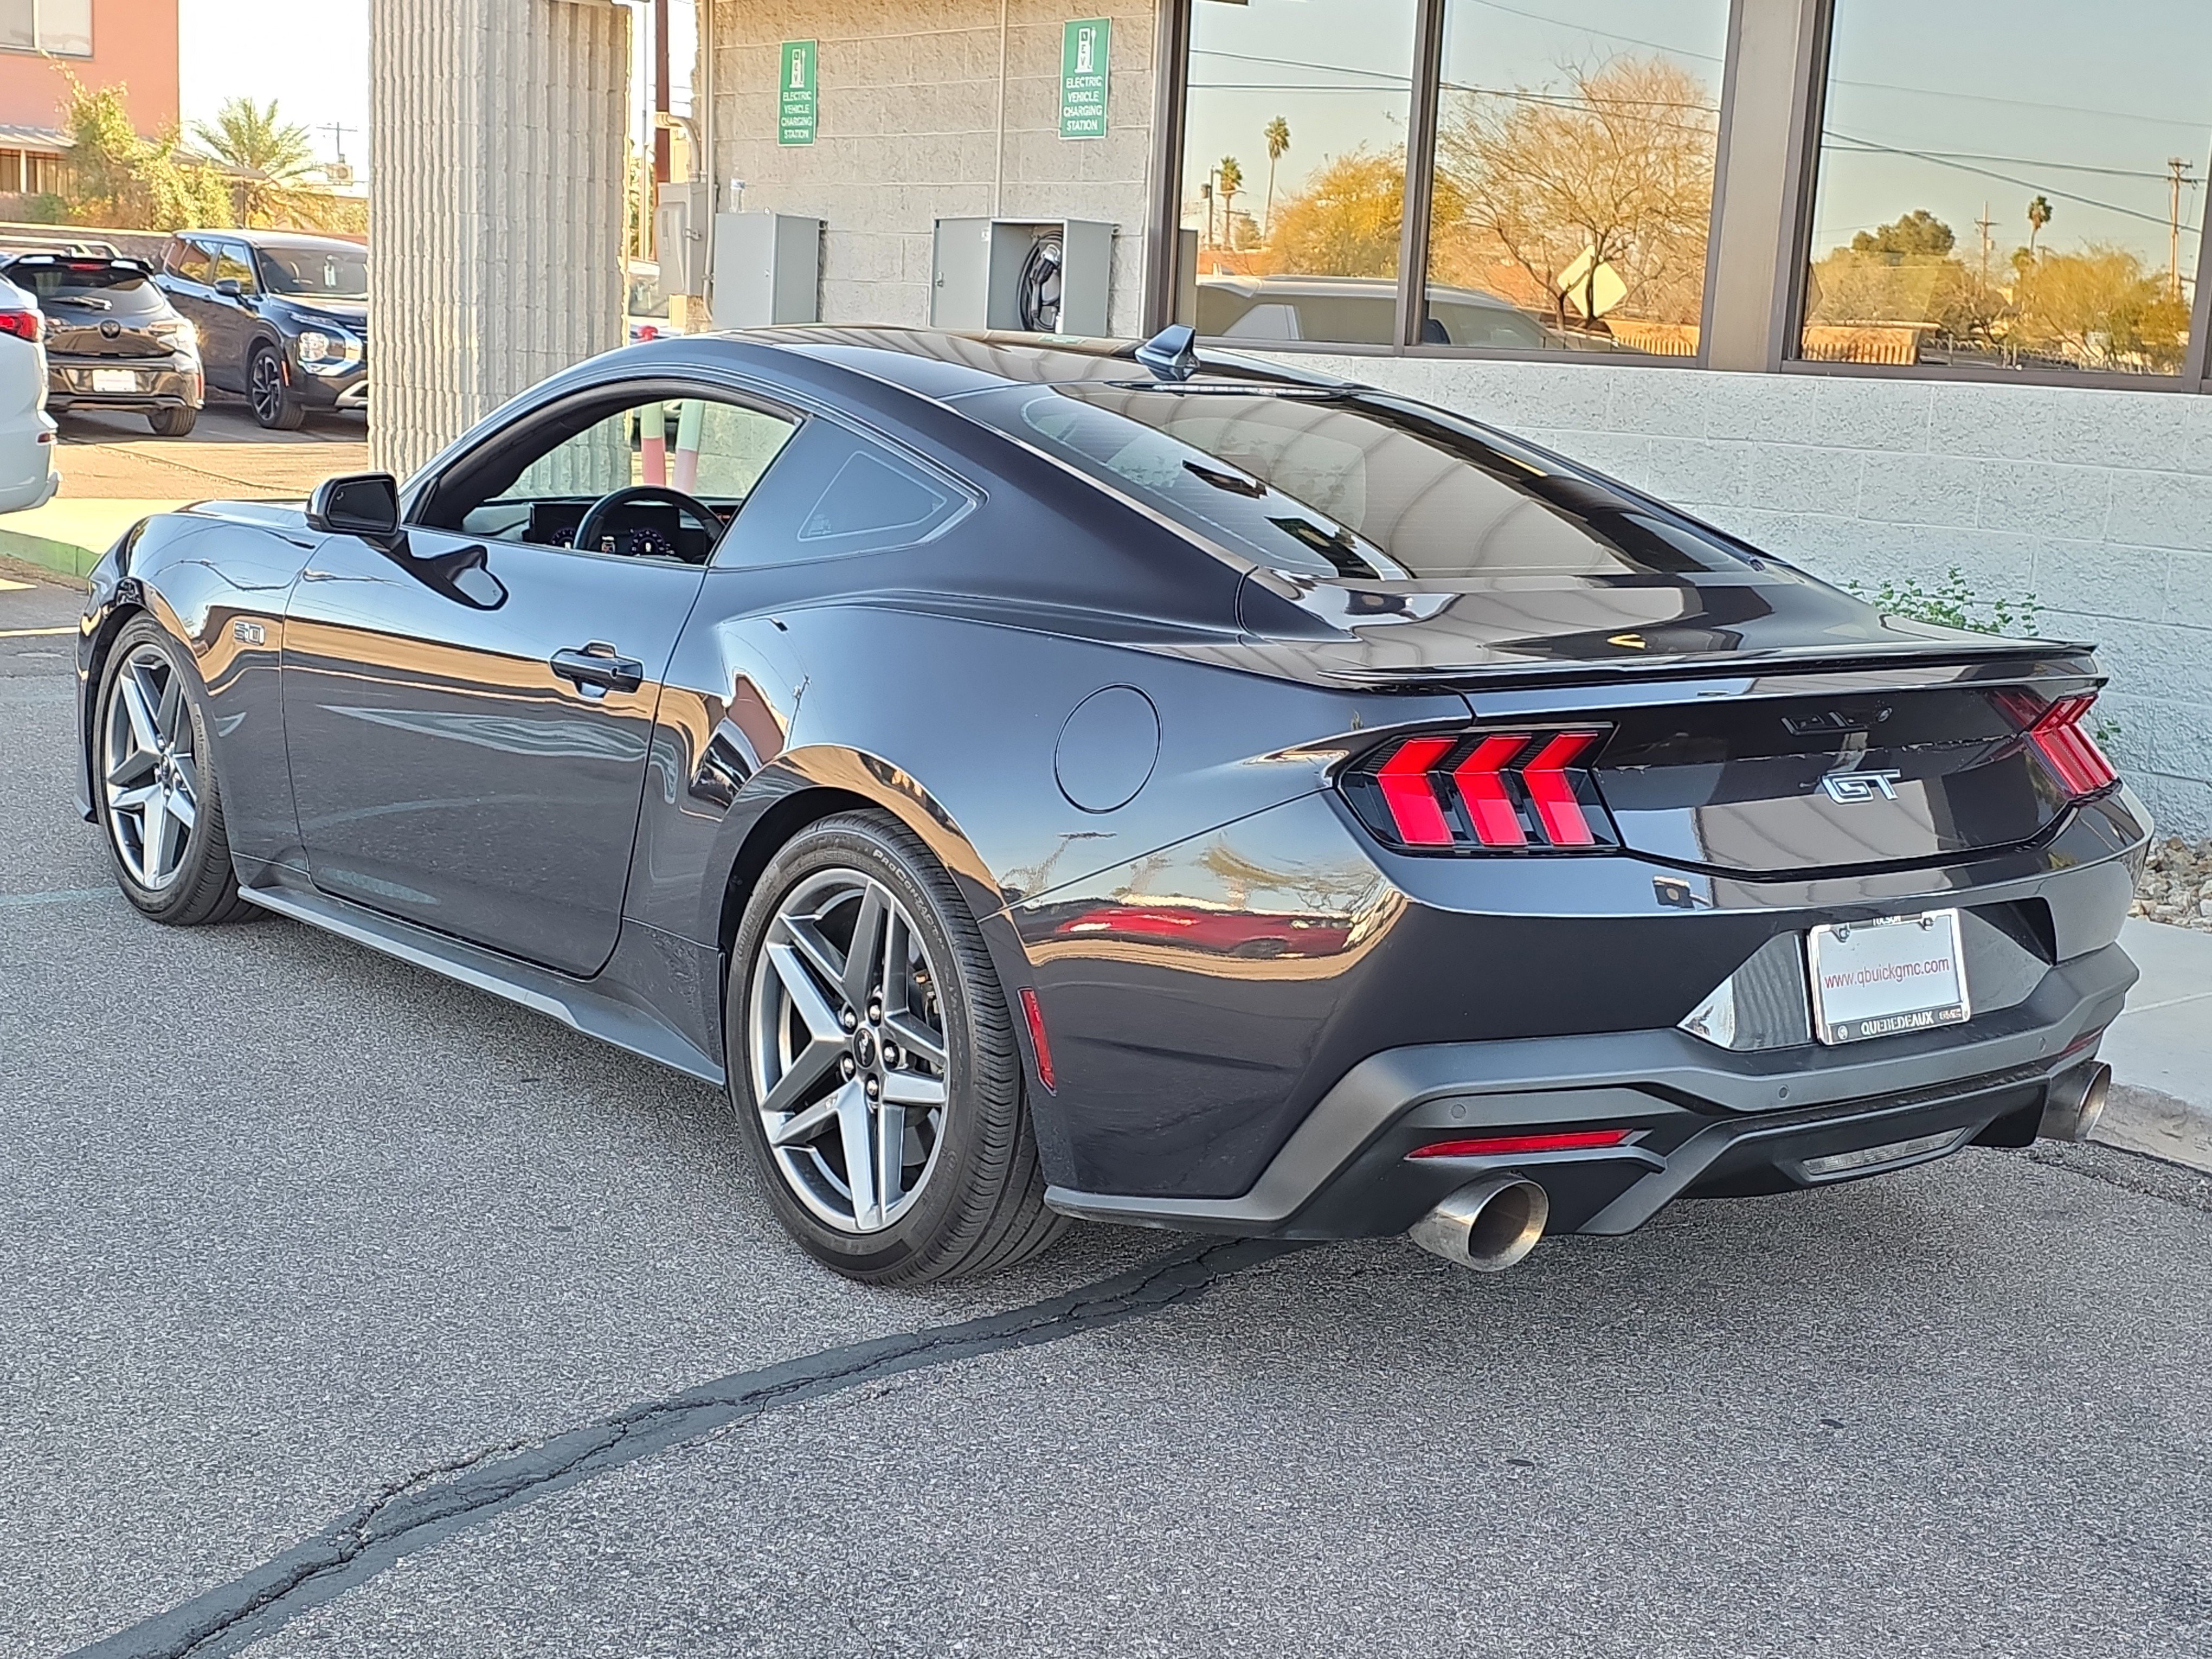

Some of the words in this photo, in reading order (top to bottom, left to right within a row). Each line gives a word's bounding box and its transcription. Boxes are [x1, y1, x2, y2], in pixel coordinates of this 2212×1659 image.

[1066, 75, 1103, 89] ELECTRIC
[782, 91, 812, 101] ELECTRIC
[1068, 91, 1099, 103] VEHICLE
[784, 104, 810, 114] VEHICLE
[1063, 105, 1103, 118] CHARGING
[781, 116, 813, 127] CHARGING
[1066, 119, 1098, 131] STATION
[784, 129, 809, 139] STATION
[1821, 768, 1901, 806] GT
[1824, 957, 1950, 988] www.qbuickgmc.com
